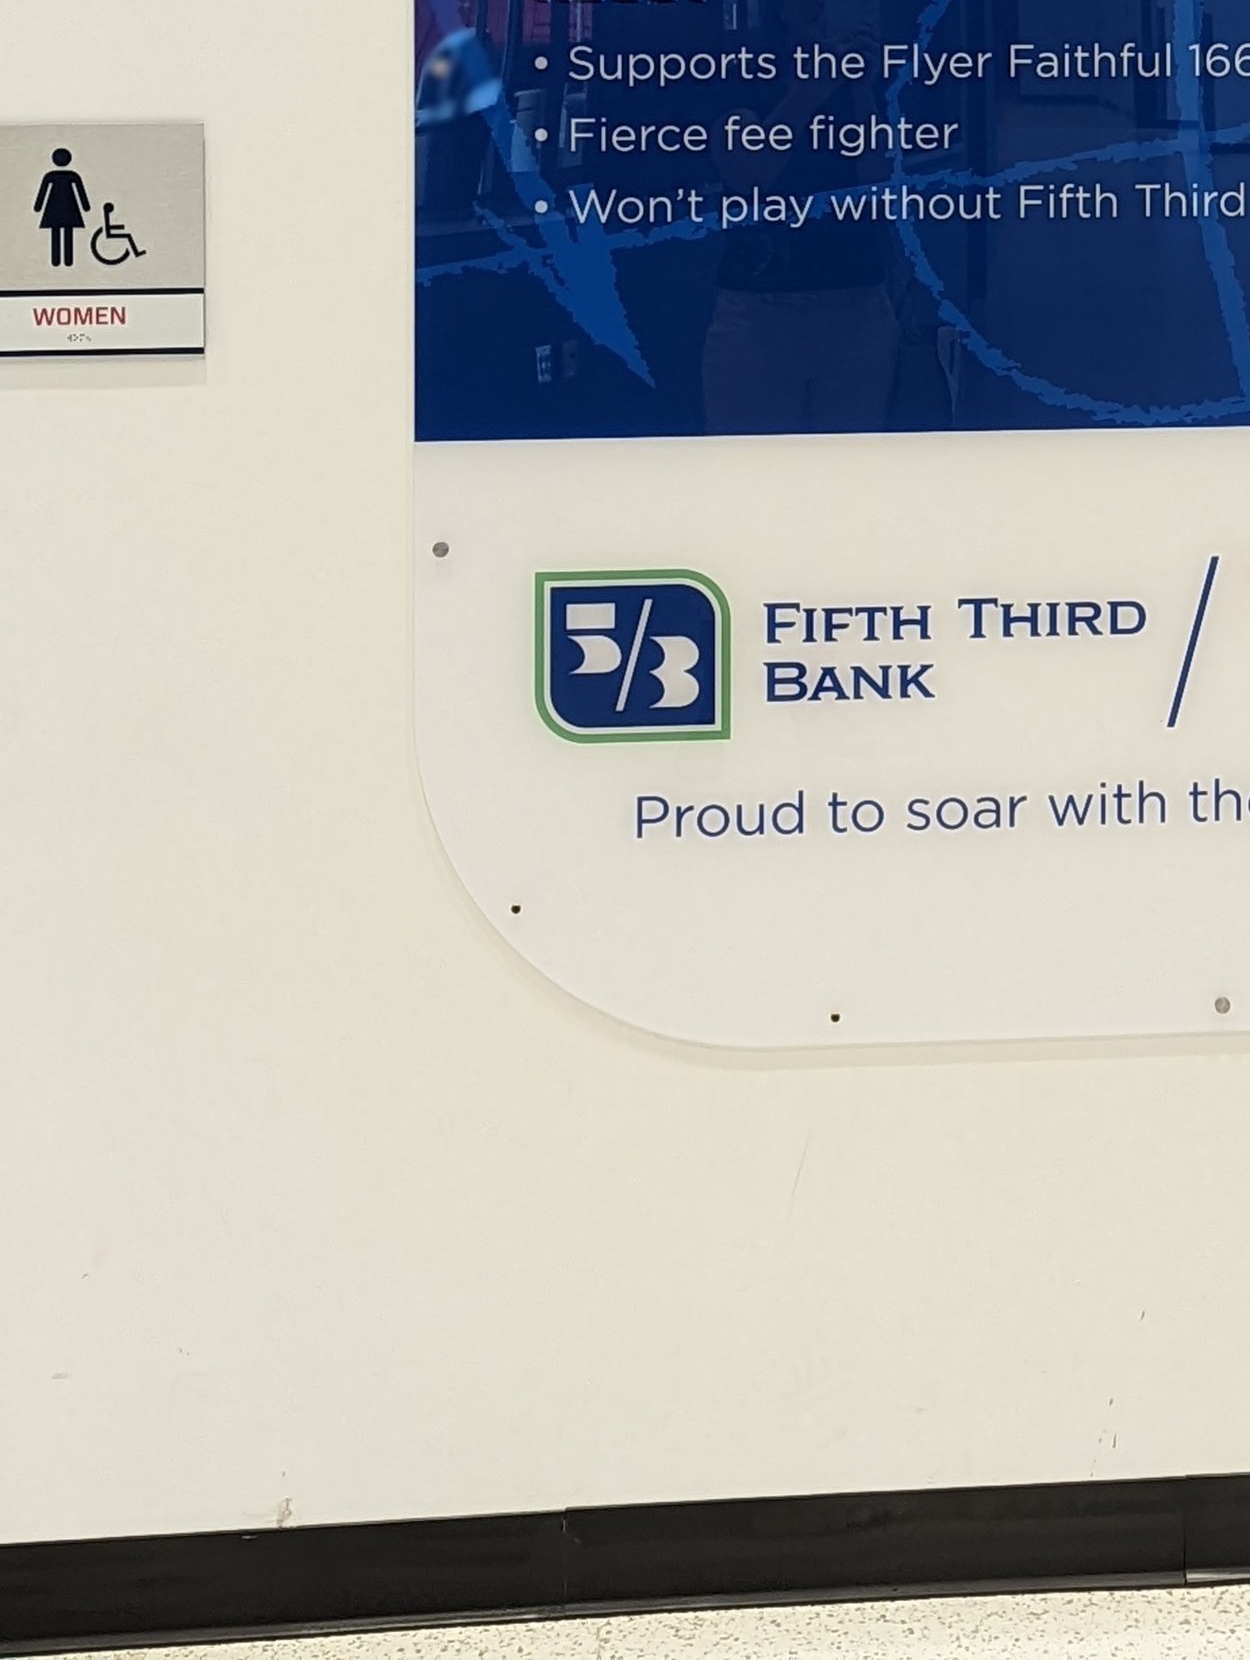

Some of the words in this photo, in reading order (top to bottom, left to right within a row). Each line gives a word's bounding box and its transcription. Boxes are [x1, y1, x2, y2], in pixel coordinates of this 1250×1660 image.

[569, 46, 776, 87] Supports
[793, 44, 865, 79] the
[884, 43, 992, 85] Flyer
[1010, 43, 1171, 78] Faithful
[571, 118, 707, 152] Fierce
[724, 115, 793, 151] fee
[810, 115, 958, 156] fighter
[569, 189, 703, 223] Won't
[722, 186, 813, 229] play
[831, 185, 1001, 221] without
[1020, 183, 1117, 218] Fifth
[1135, 182, 1245, 217] Third
[33, 306, 126, 326] WOMEN
[637, 790, 804, 839] Proud
[827, 792, 885, 834] to
[906, 795, 1028, 831] soar
[1048, 780, 1166, 827] with
